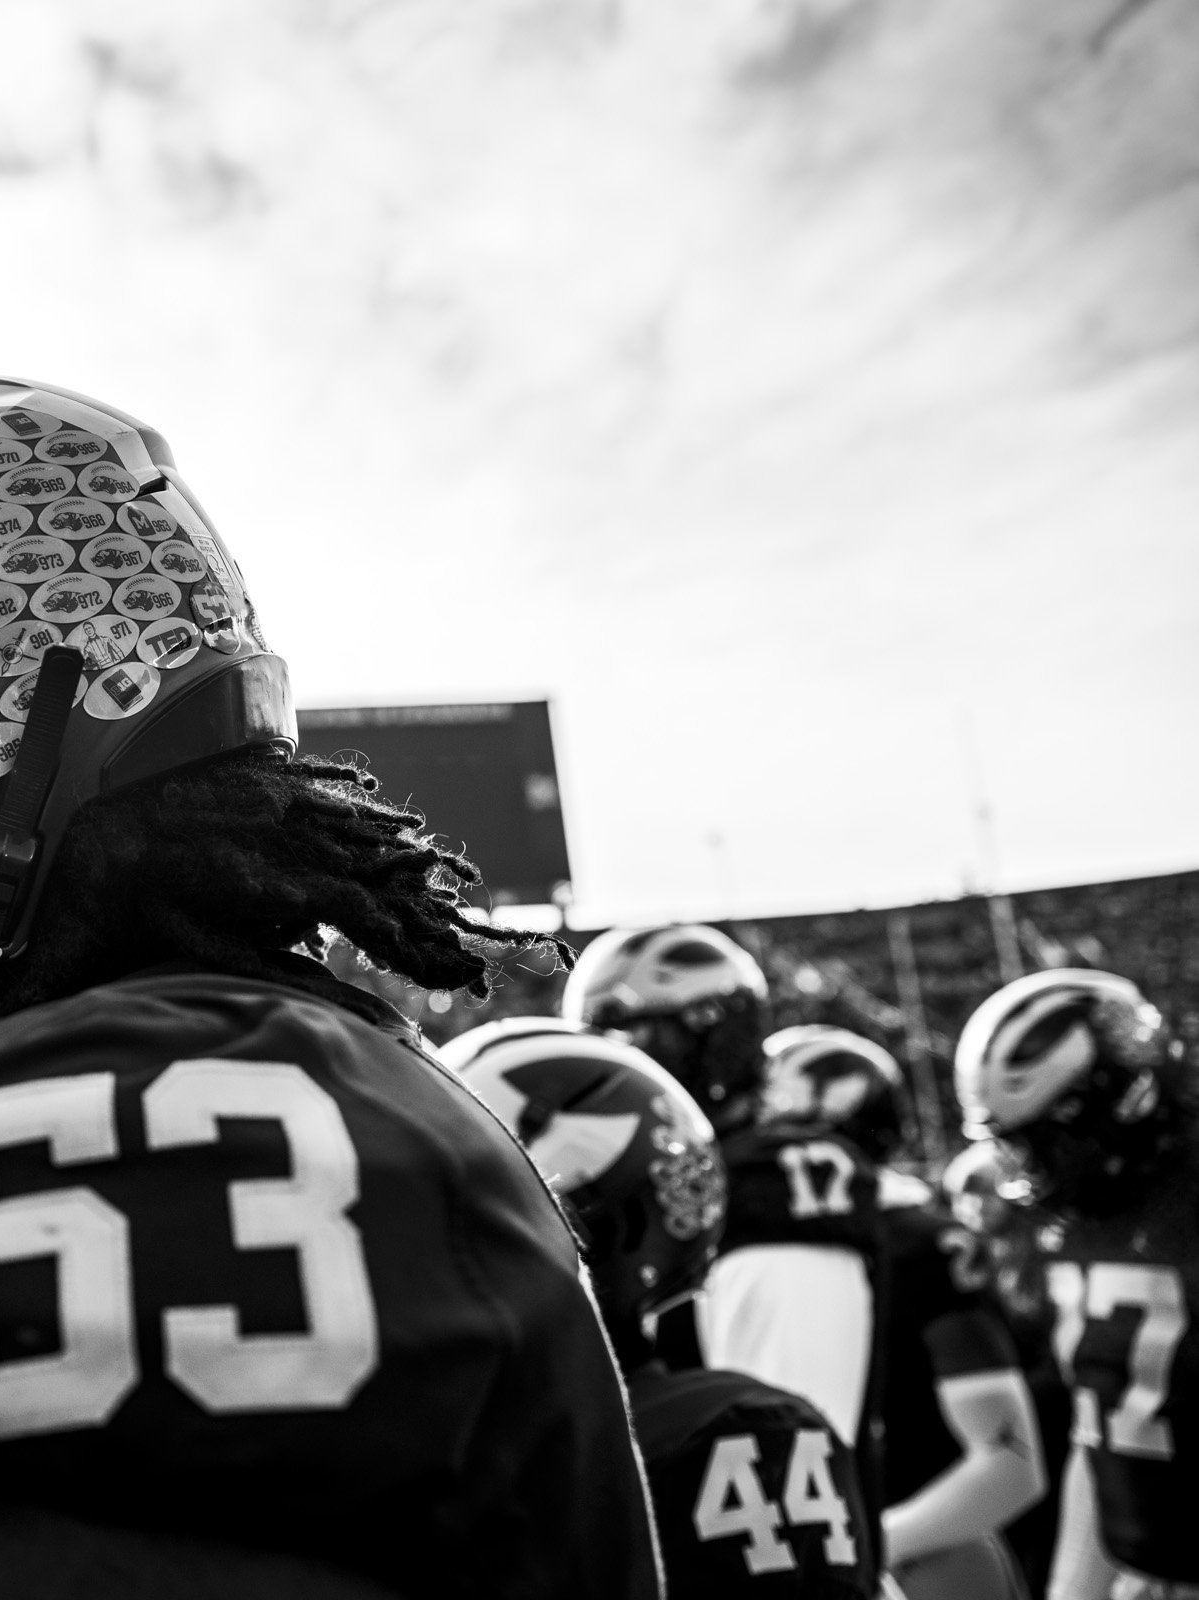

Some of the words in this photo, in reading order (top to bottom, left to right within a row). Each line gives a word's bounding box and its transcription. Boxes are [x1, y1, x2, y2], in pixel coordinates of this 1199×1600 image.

[41, 477, 66, 493] 969
[115, 481, 136, 495] 964
[82, 513, 106, 529] 968
[132, 515, 150, 530] M
[152, 519, 172, 532] 963
[39, 553, 64, 571] 973
[123, 551, 143, 567] 967
[184, 558, 203, 573] 962
[78, 590, 103, 609] 972
[152, 592, 174, 609] 966
[110, 620, 133, 640] 971
[29, 629, 54, 650] 981
[145, 626, 193, 658] TED
[693, 1430, 857, 1575] 44
